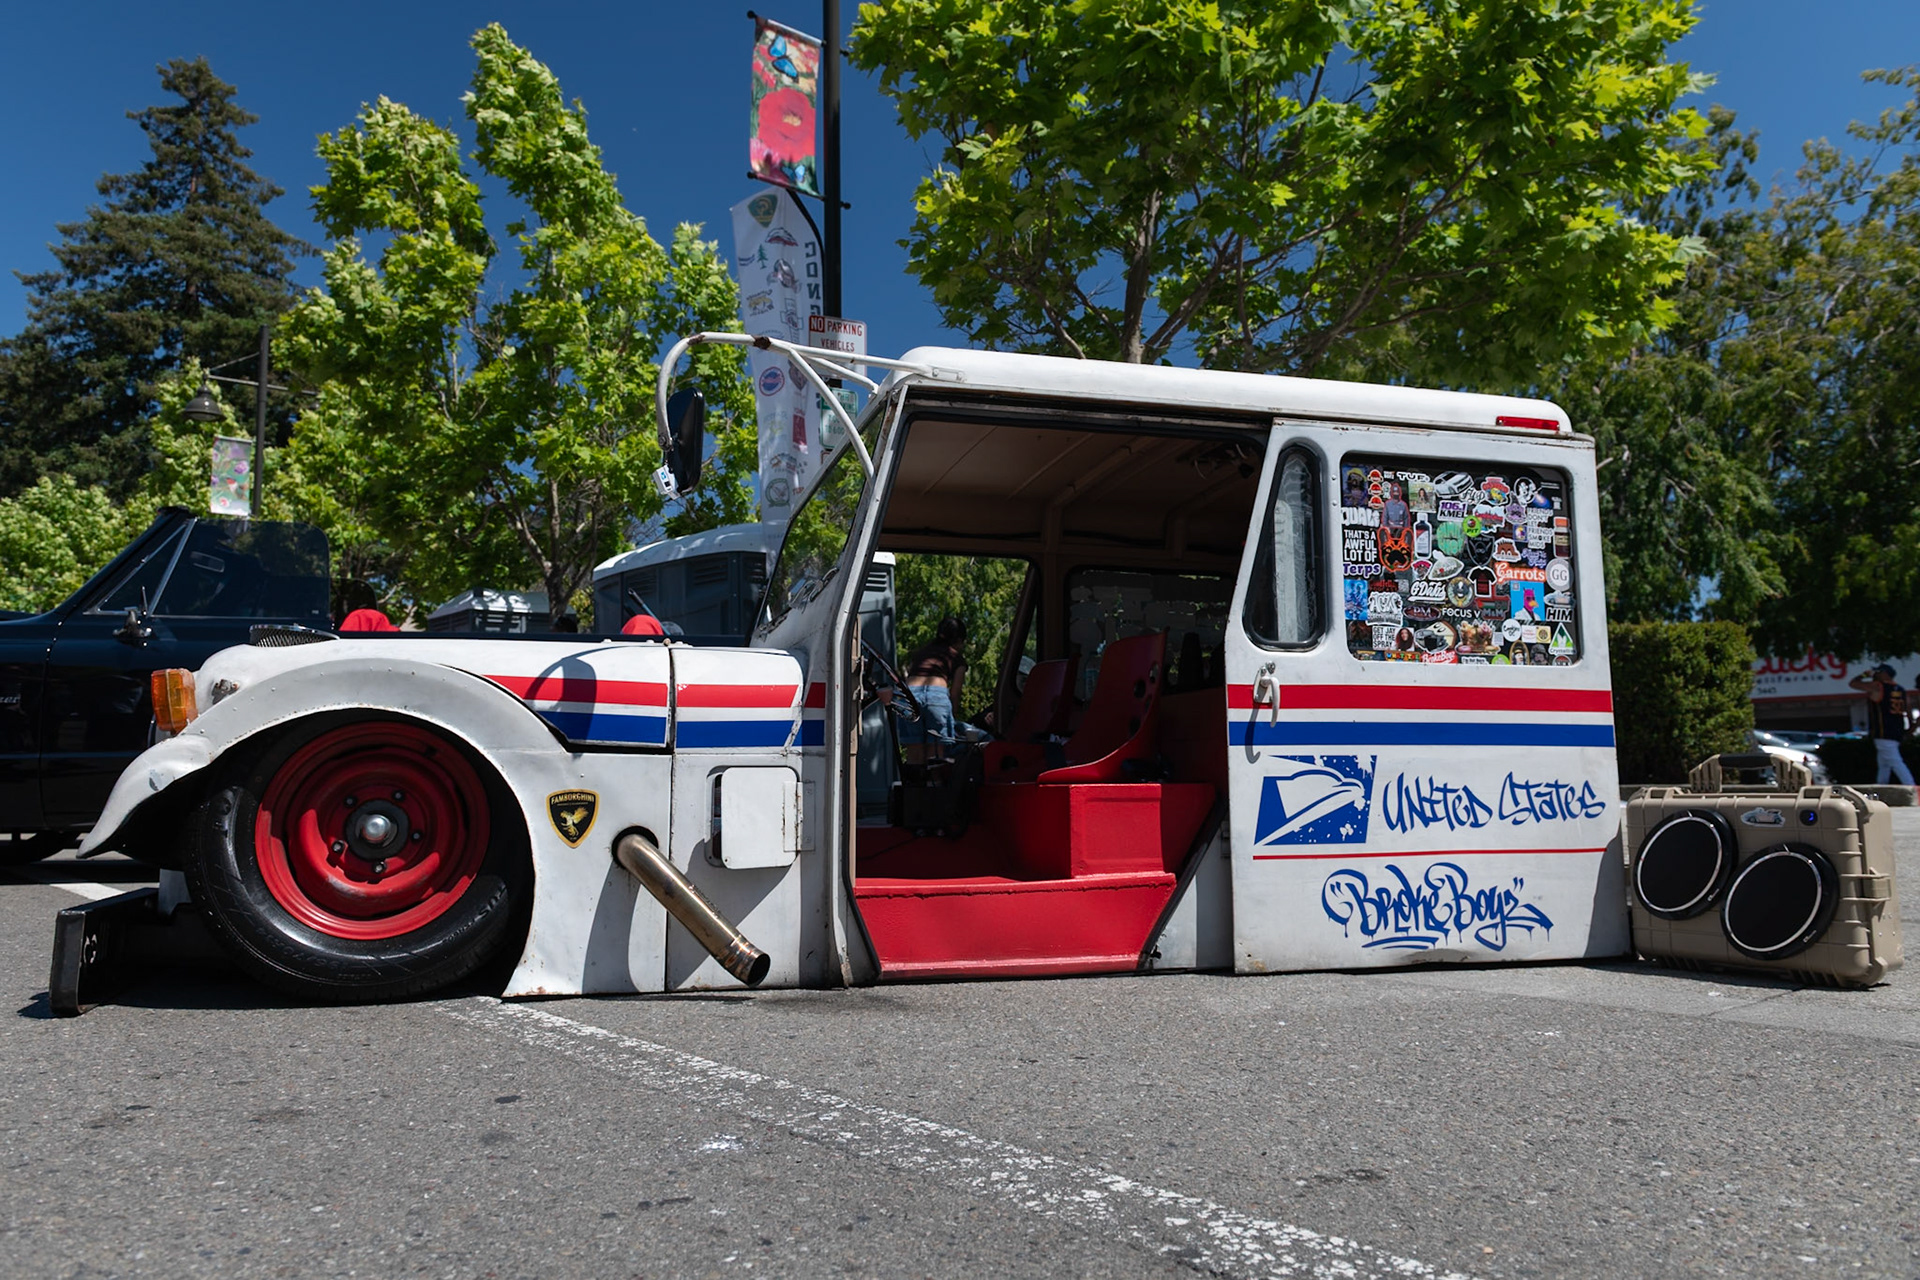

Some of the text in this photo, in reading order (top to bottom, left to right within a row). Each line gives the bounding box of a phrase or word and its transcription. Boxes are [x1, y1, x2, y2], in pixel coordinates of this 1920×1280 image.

[810, 317, 862, 336] NO PARKING
[821, 338, 855, 352] VEHICLES
[1440, 501, 1466, 511] 106.1
[1440, 510, 1465, 518] KMEL
[1344, 529, 1377, 540] THAT'S A
[1528, 528, 1553, 536] FRIENDS
[1344, 539, 1377, 550] AWFUL
[1344, 549, 1377, 562] LOT OF
[1343, 563, 1380, 578] Terps
[1496, 563, 1545, 581] Carrots
[1442, 608, 1472, 618] FOCUS
[1547, 607, 1573, 621] HIM
